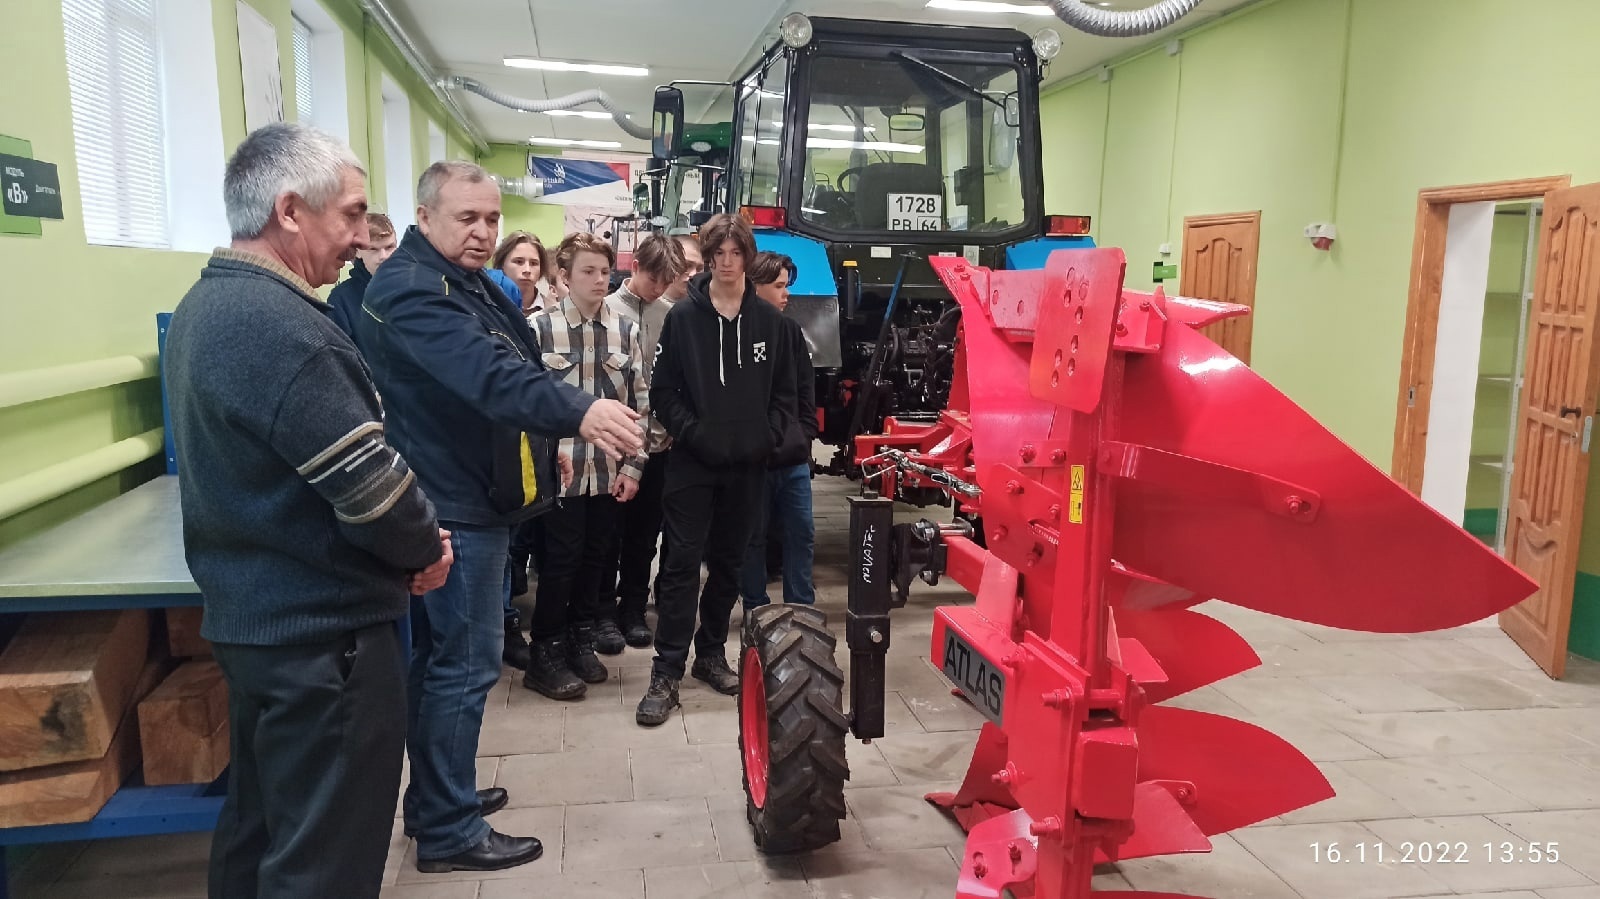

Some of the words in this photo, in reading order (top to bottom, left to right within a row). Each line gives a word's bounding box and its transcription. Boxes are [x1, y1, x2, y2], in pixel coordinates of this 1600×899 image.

[895, 195, 936, 214] 1728
[921, 219, 937, 231] 64
[945, 636, 1002, 715] ATLAS
